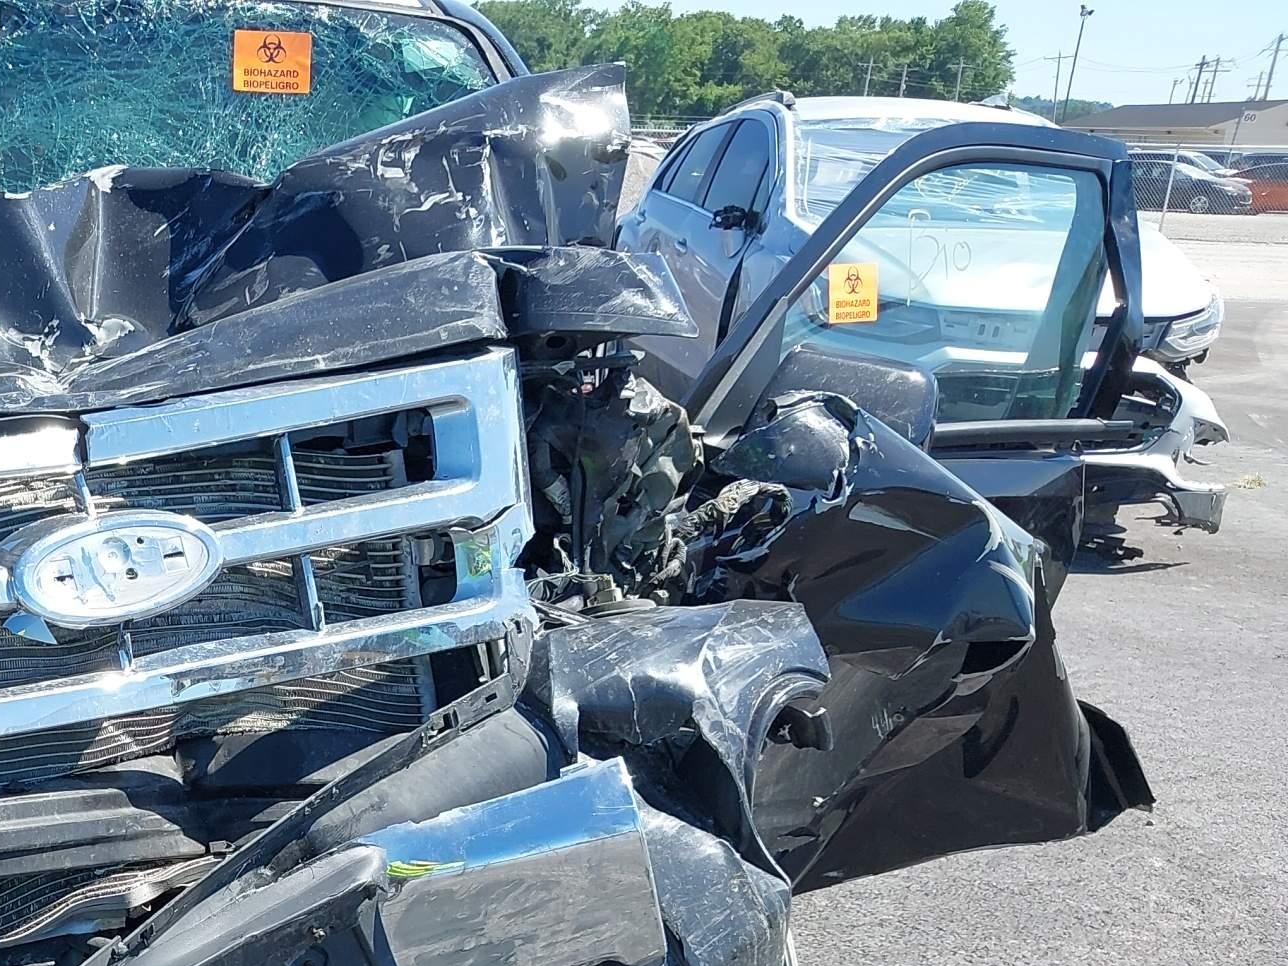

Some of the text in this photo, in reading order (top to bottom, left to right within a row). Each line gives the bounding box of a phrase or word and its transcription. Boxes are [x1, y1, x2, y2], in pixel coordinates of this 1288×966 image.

[243, 68, 300, 79] BIOHAZARD
[243, 79, 300, 90] BIOPELIGRO
[1243, 112, 1257, 122] 60
[835, 299, 871, 309] BIOHAZARD
[835, 310, 871, 321] BIOPELIGRO
